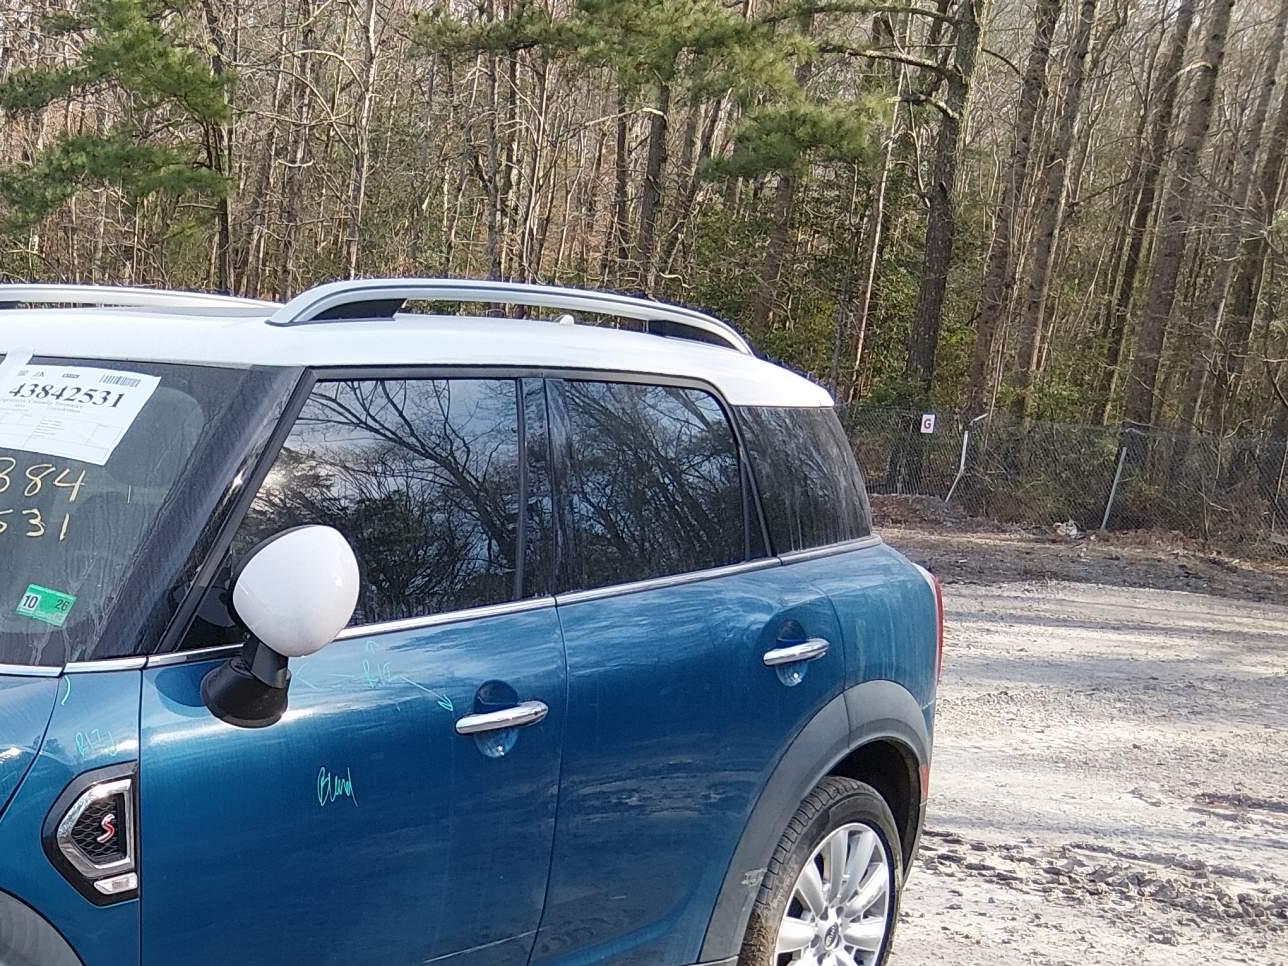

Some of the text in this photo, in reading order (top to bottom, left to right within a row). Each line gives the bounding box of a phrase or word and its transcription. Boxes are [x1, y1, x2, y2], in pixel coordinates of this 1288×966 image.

[8, 382, 125, 409] 43842531
[923, 418, 932, 430] G
[23, 594, 39, 609] 10
[96, 812, 116, 844] S
